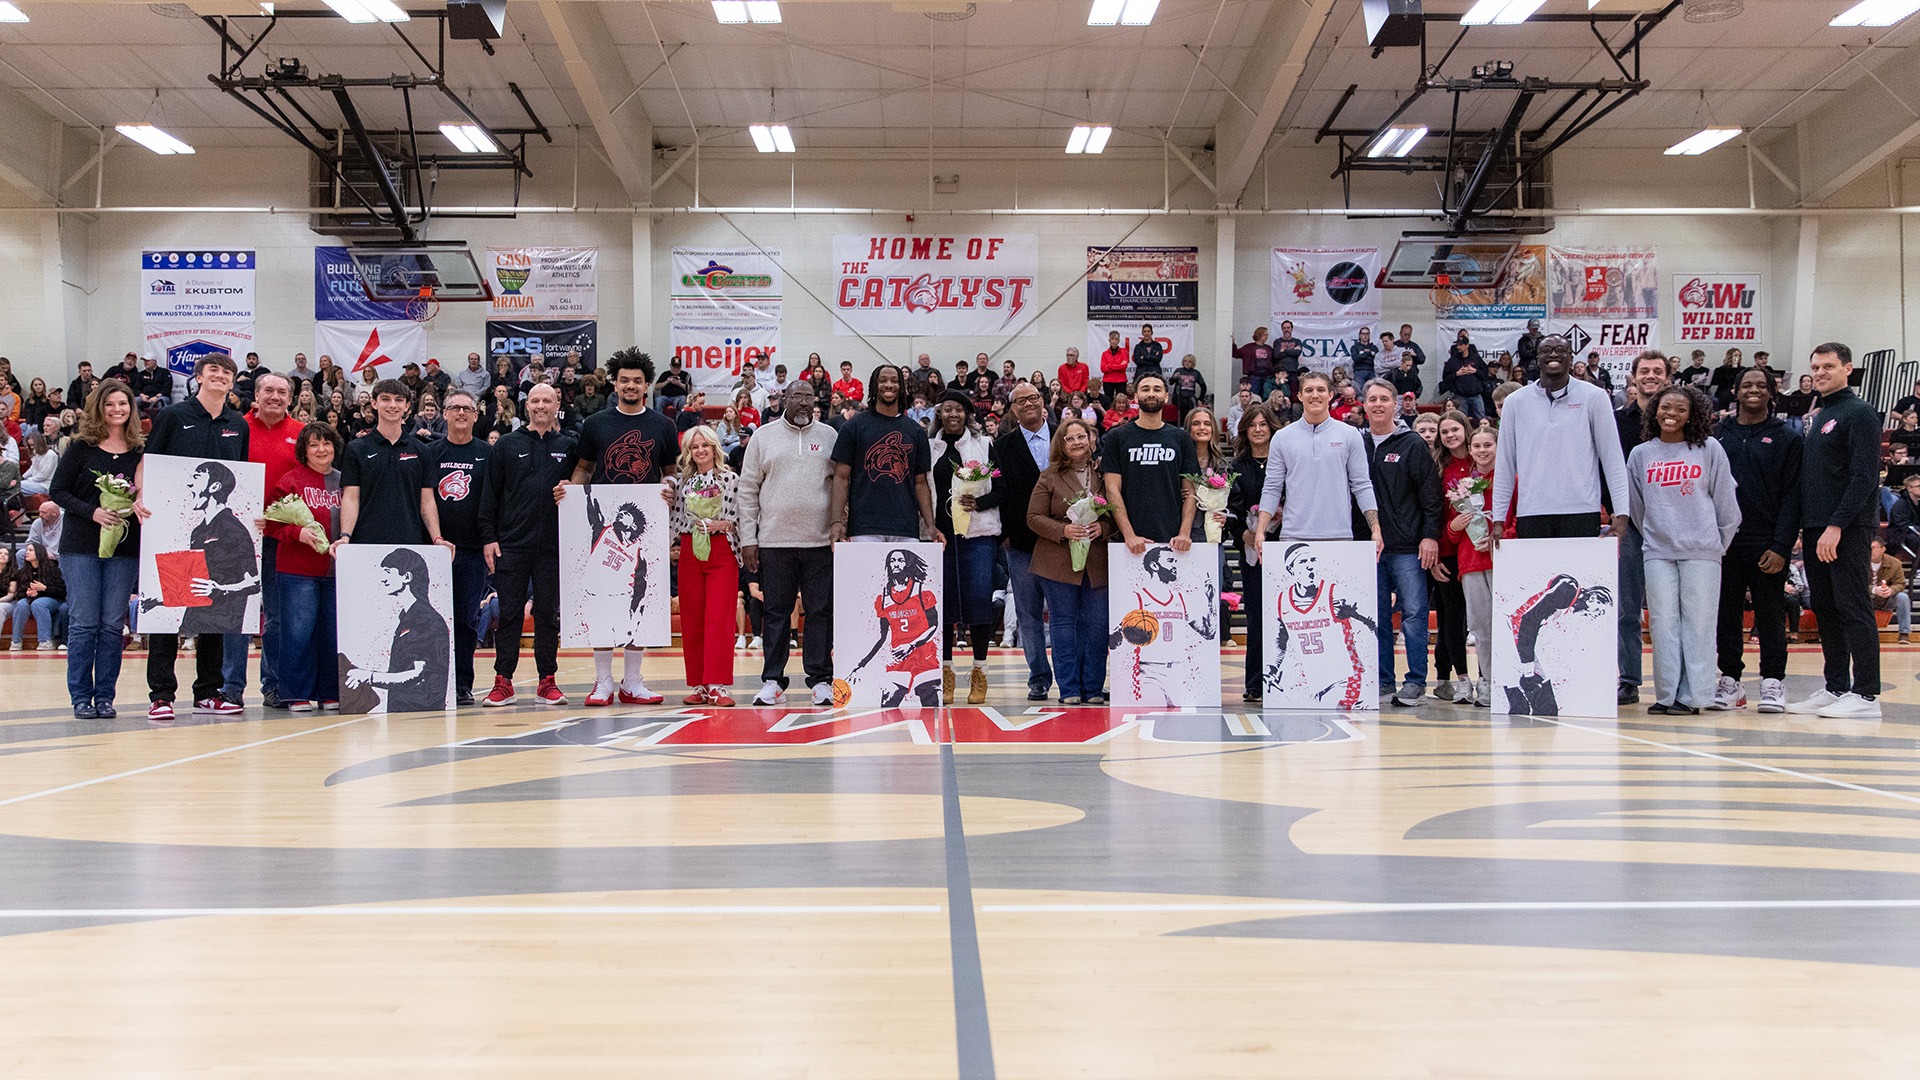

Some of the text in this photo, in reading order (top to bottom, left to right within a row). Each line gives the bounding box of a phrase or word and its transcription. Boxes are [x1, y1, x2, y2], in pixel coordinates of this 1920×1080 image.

[868, 238, 1004, 260] HOME OF
[497, 254, 531, 266] CASA
[842, 262, 869, 274] THE
[1109, 283, 1179, 297] SUMMIT
[1705, 283, 1755, 309] IWU
[493, 296, 535, 308] BRAVA
[1682, 312, 1753, 325] WILDCAT
[1600, 324, 1649, 345] FEAR
[1681, 327, 1755, 340] PEP BAND
[491, 337, 542, 354] OPS
[560, 344, 582, 353] wayne
[1301, 339, 1358, 358] STA
[1592, 347, 1647, 356] POWERSPORTS
[675, 338, 776, 376] meijer
[1128, 445, 1176, 463] THIRD
[440, 462, 474, 470] WILDCATS
[1646, 464, 1702, 484] THIRD
[304, 487, 342, 509] Wildcat
[602, 550, 626, 571] 35
[900, 618, 908, 632] 2
[1162, 622, 1172, 642] 0
[1286, 618, 1330, 630] WILDCATS
[1298, 632, 1324, 654] 25
